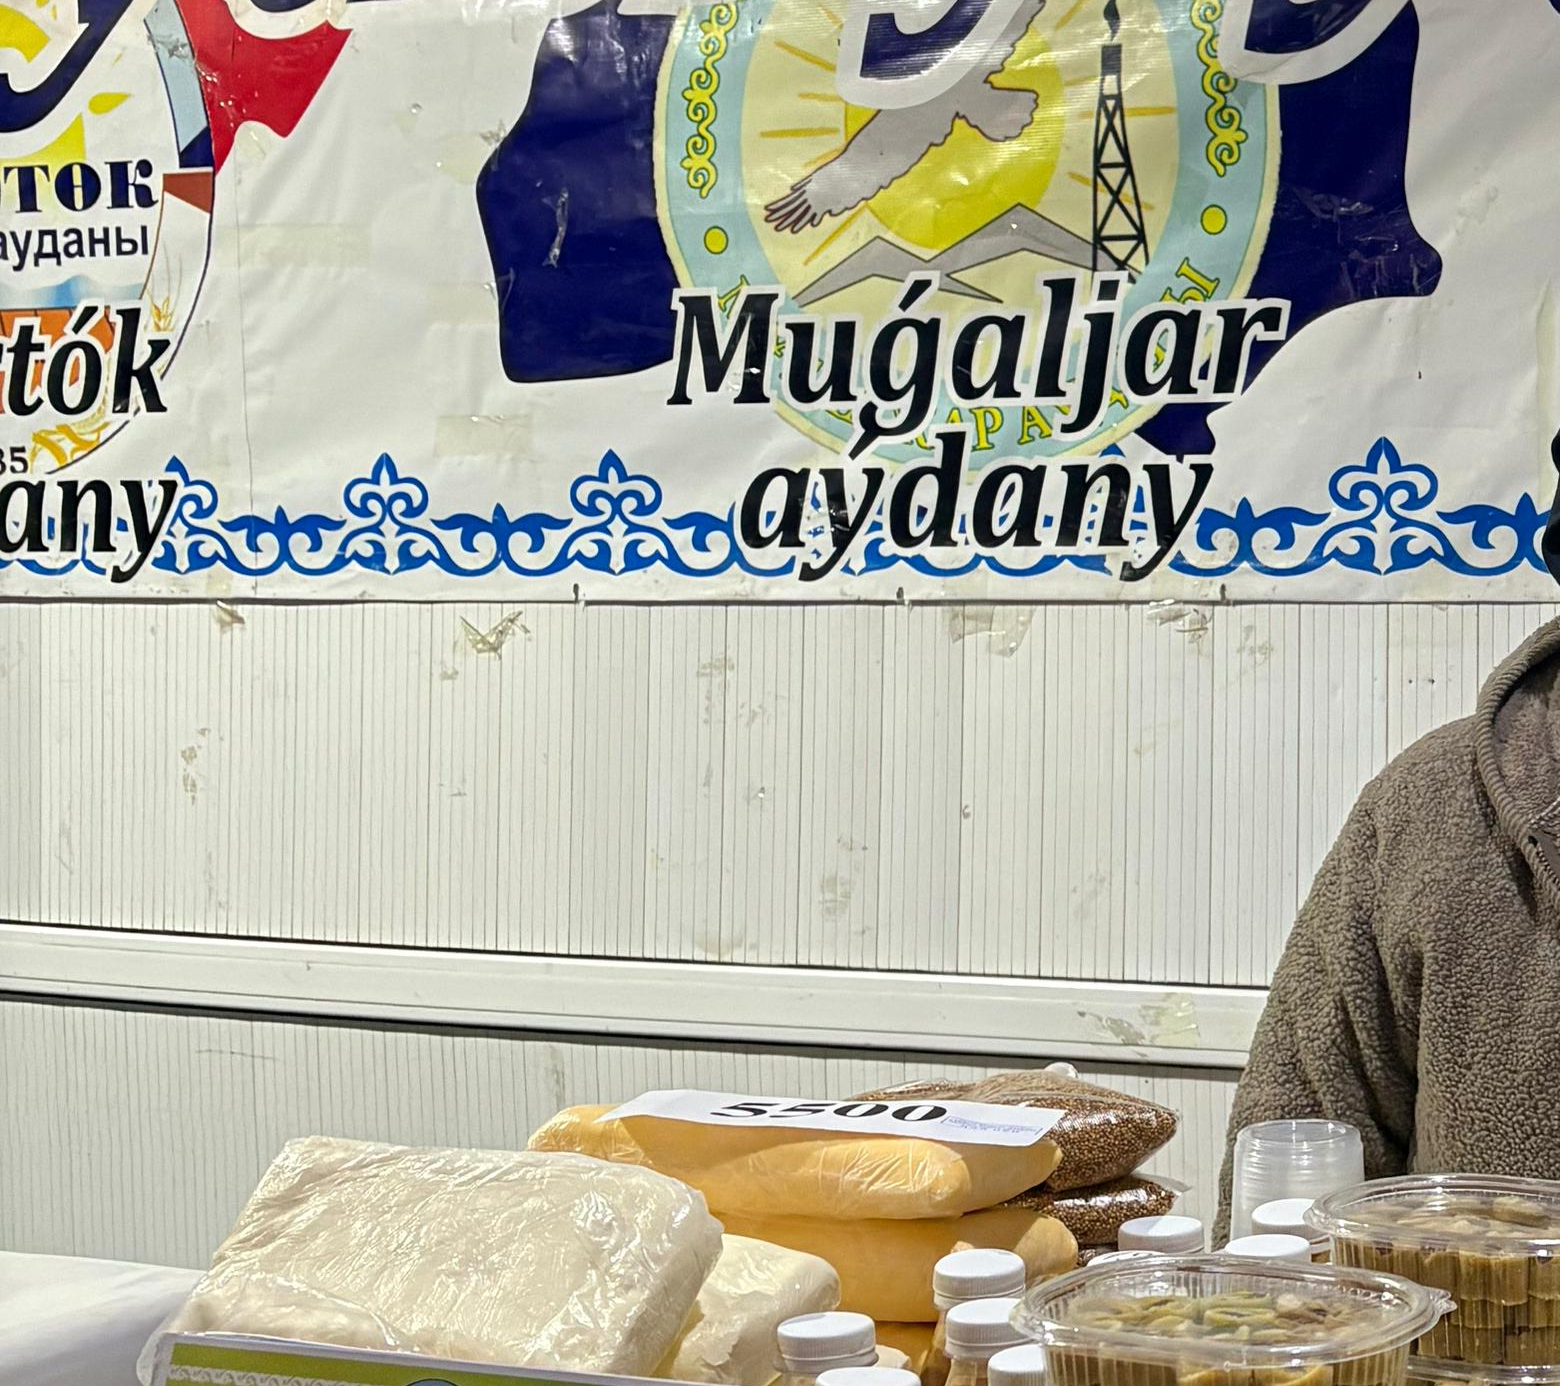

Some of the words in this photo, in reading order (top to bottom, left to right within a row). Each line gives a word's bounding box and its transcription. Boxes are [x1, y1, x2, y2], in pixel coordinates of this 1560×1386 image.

[0, 305, 171, 416] tók
[740, 431, 1213, 582] aýdany
[710, 1102, 947, 1122] 5500
